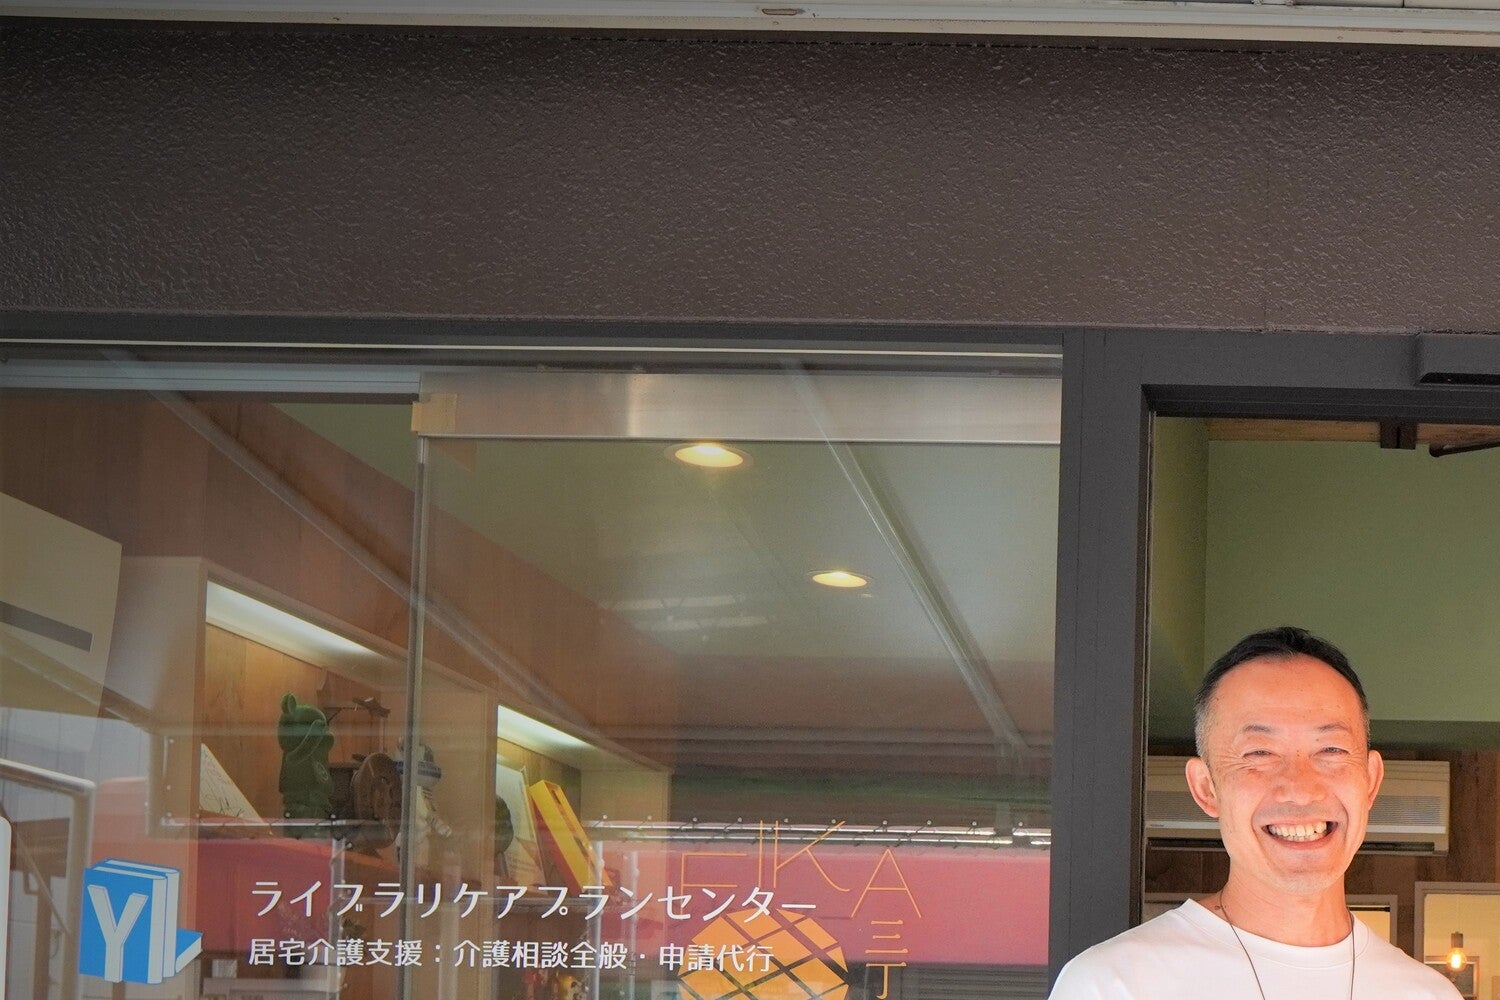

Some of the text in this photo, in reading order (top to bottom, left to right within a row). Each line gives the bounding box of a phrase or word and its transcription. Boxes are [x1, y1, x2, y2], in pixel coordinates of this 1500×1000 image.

[251, 880, 817, 923] ライブラリケアプランセンター
[680, 820, 922, 918] FIKA
